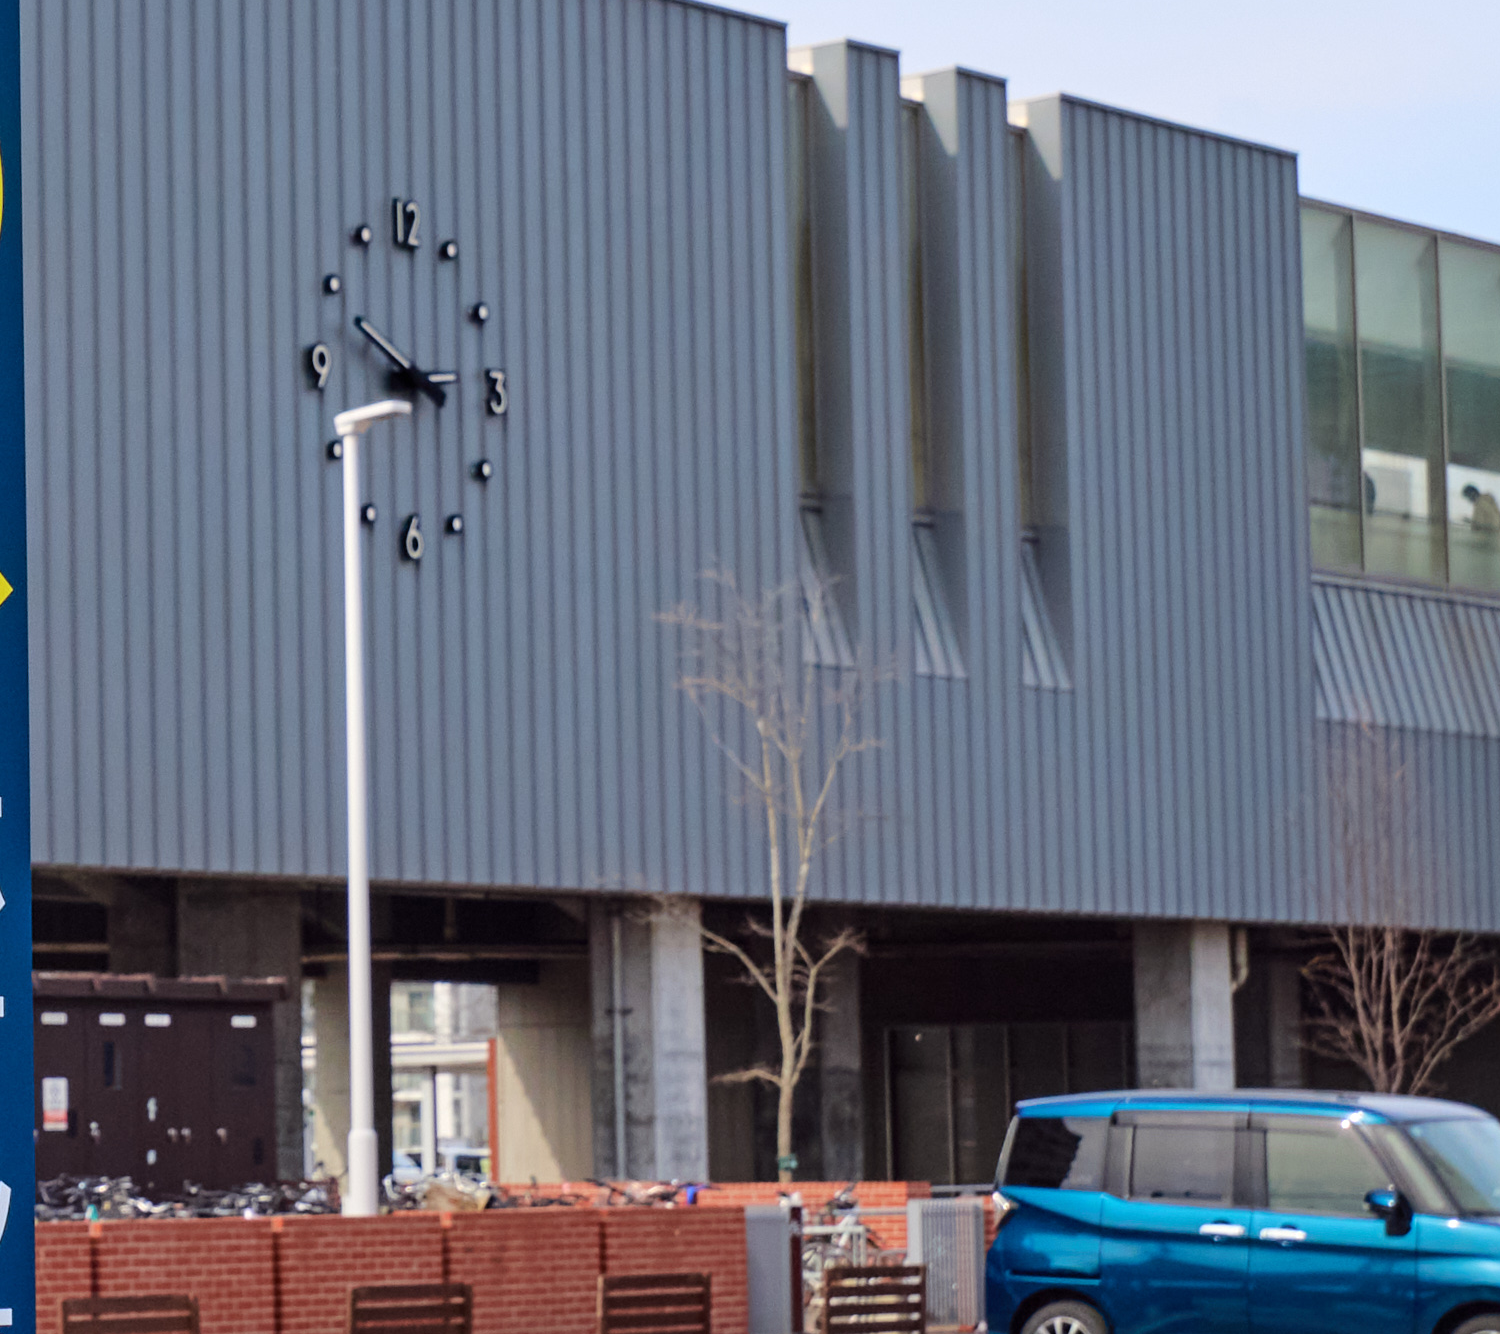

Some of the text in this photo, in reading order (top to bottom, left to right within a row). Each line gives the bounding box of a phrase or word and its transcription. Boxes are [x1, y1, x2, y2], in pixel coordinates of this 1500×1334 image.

[392, 196, 422, 250] 12
[308, 342, 332, 391] 9
[486, 368, 508, 416] 3
[402, 513, 425, 562] 6
